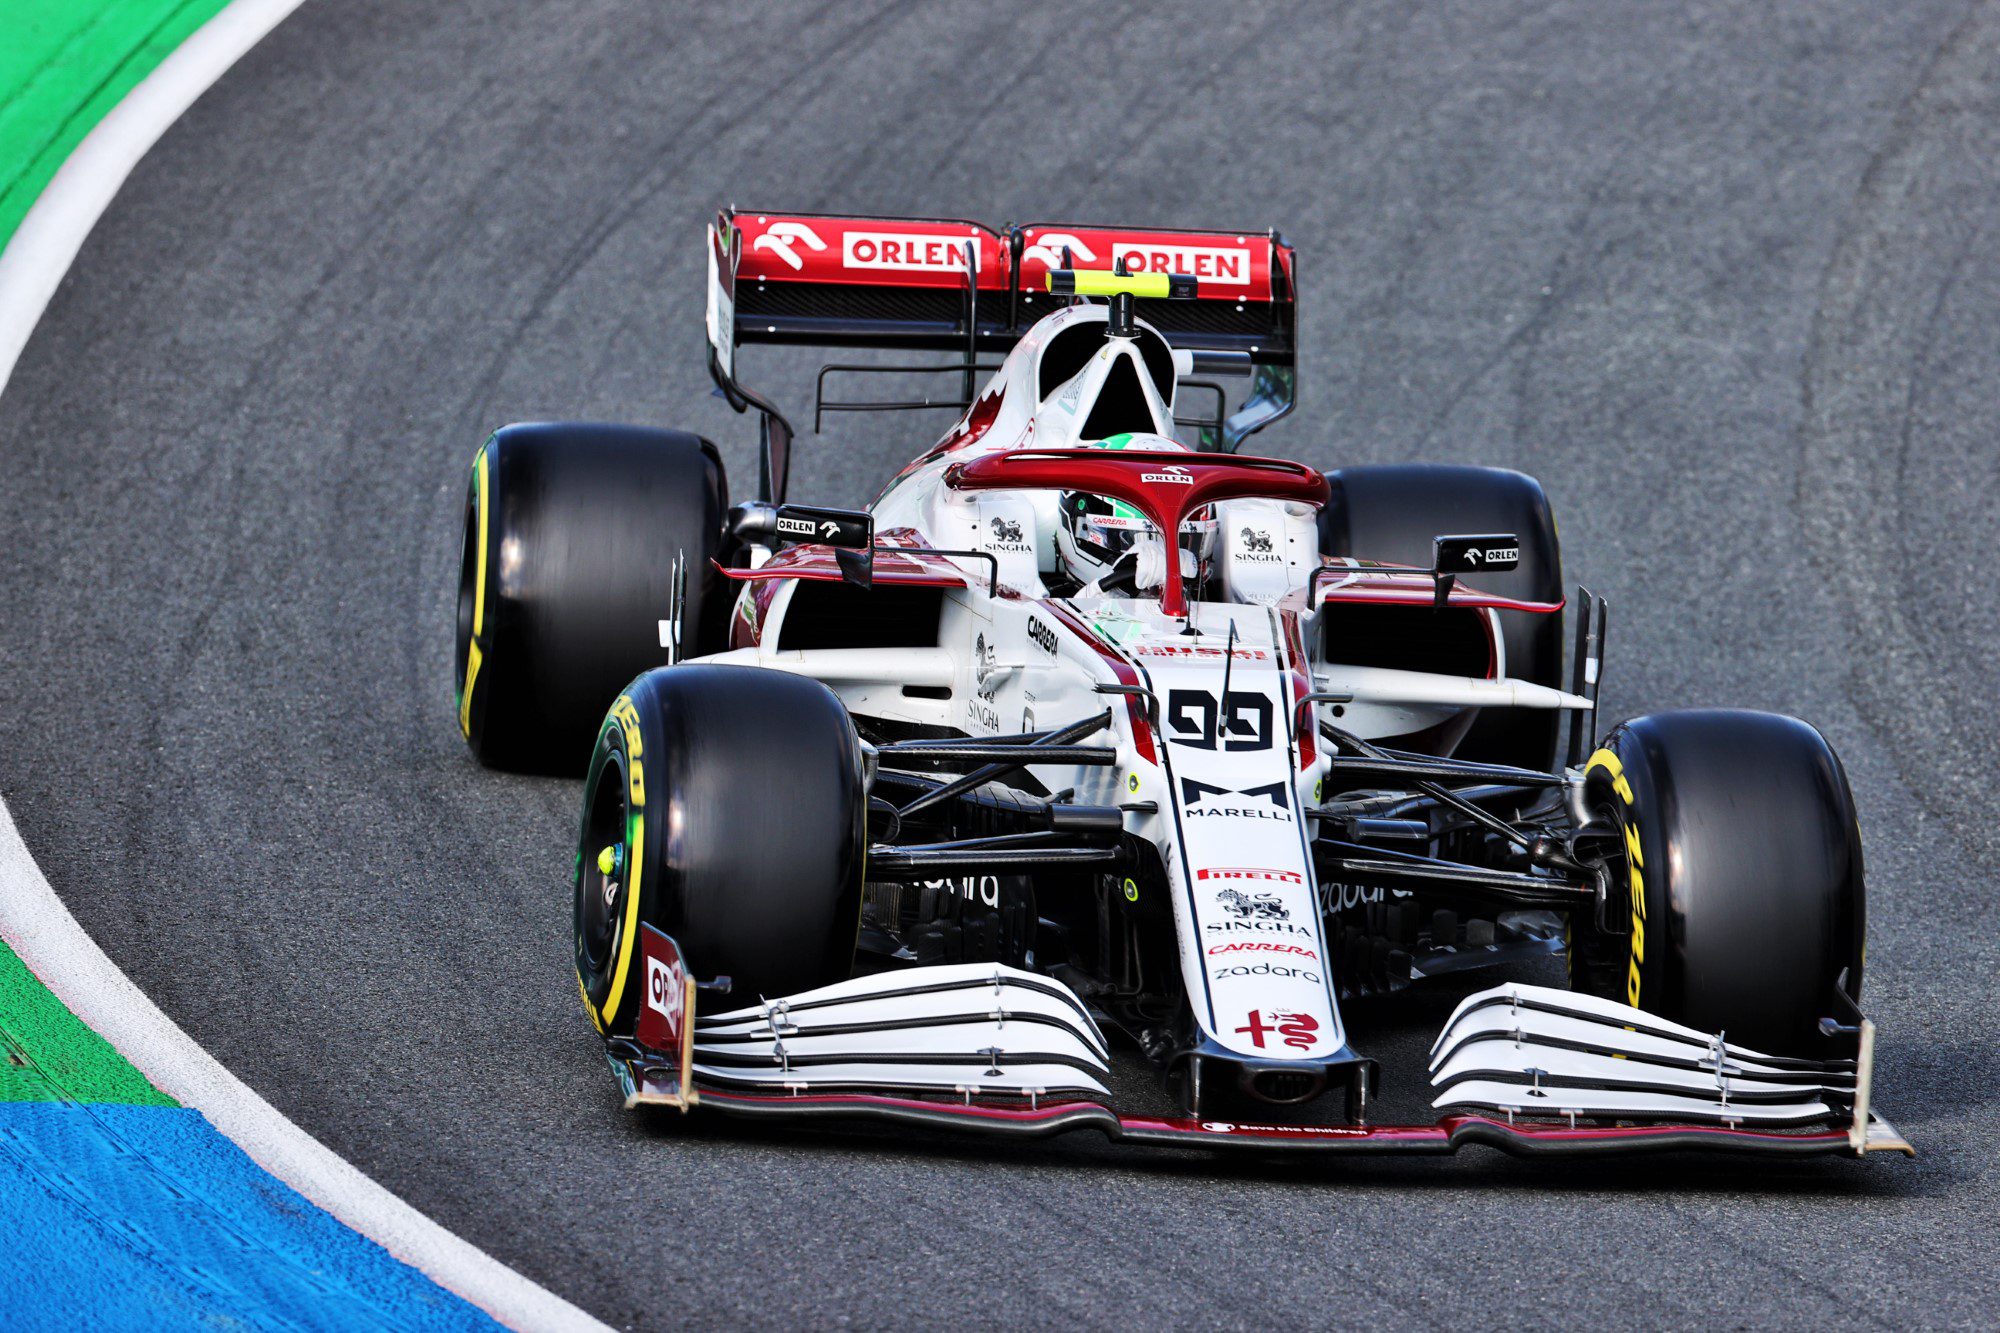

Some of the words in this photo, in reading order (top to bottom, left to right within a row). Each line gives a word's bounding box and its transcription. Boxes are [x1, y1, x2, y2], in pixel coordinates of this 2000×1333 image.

[853, 239, 972, 266] ORLEN
[1123, 250, 1240, 278] ORLEN
[1145, 474, 1190, 483] ORLEN
[778, 520, 813, 533] ORLEN
[1092, 517, 1127, 526] CARRERA
[984, 543, 1033, 552] SINGHA
[1488, 550, 1517, 560] ORLEN
[1235, 554, 1282, 562] SINGHA
[1027, 615, 1059, 660] CARRERA
[968, 699, 1000, 733] SINGHA
[1168, 688, 1273, 752] 99
[1186, 808, 1292, 822] MARELLI
[1196, 868, 1302, 884] PIRELLI
[1206, 921, 1312, 938] SINGHA
[1208, 942, 1318, 961] CARRERA
[1213, 963, 1321, 985] zadara
[1303, 1128, 1368, 1136] Children
